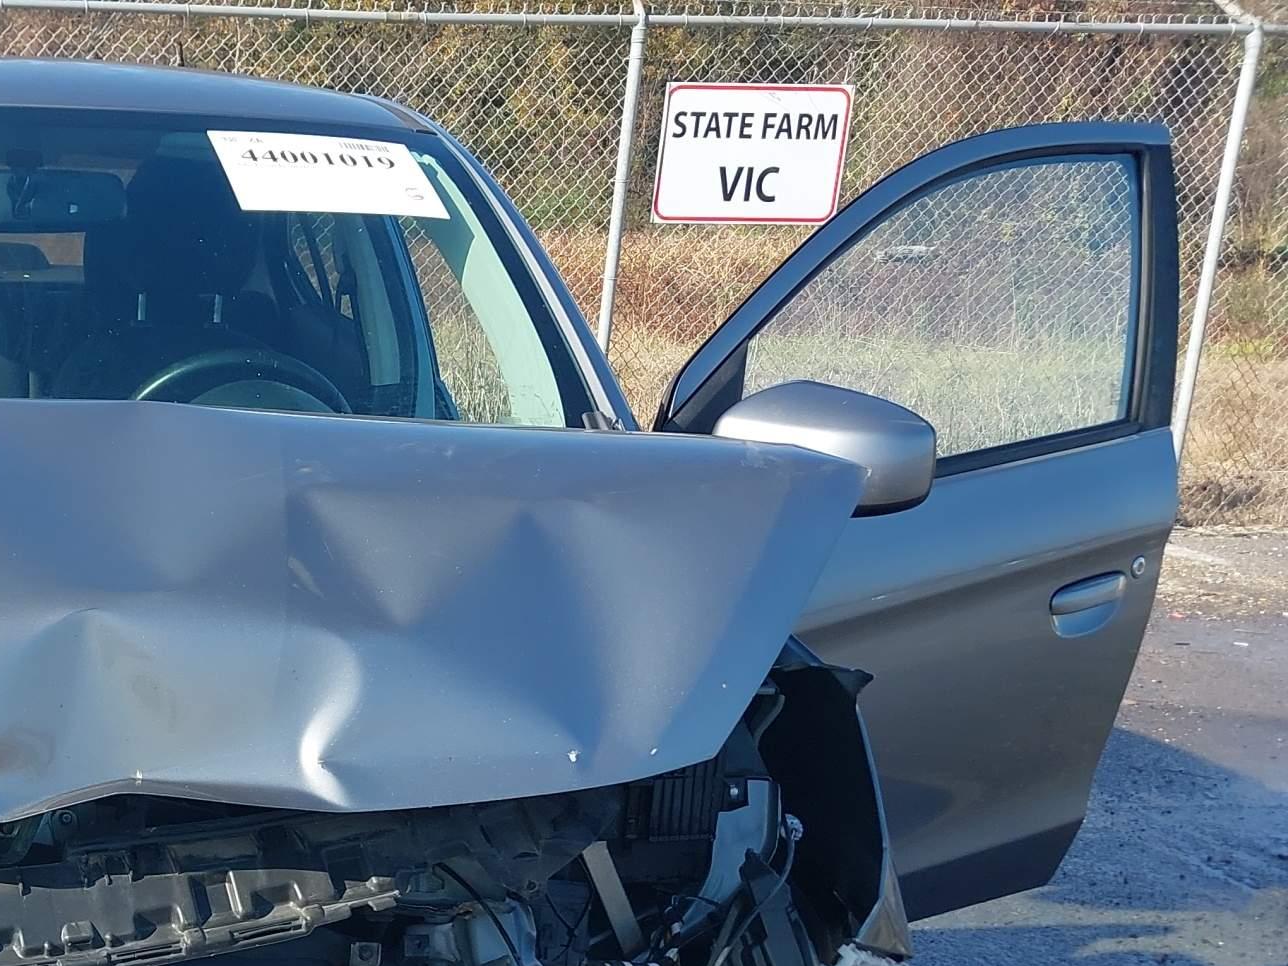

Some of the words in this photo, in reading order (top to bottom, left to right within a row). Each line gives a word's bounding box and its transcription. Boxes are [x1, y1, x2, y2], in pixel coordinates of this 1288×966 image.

[672, 111, 754, 139] STATE
[762, 112, 838, 140] FARM
[241, 148, 395, 170] 44001019
[719, 166, 780, 203] VIC
